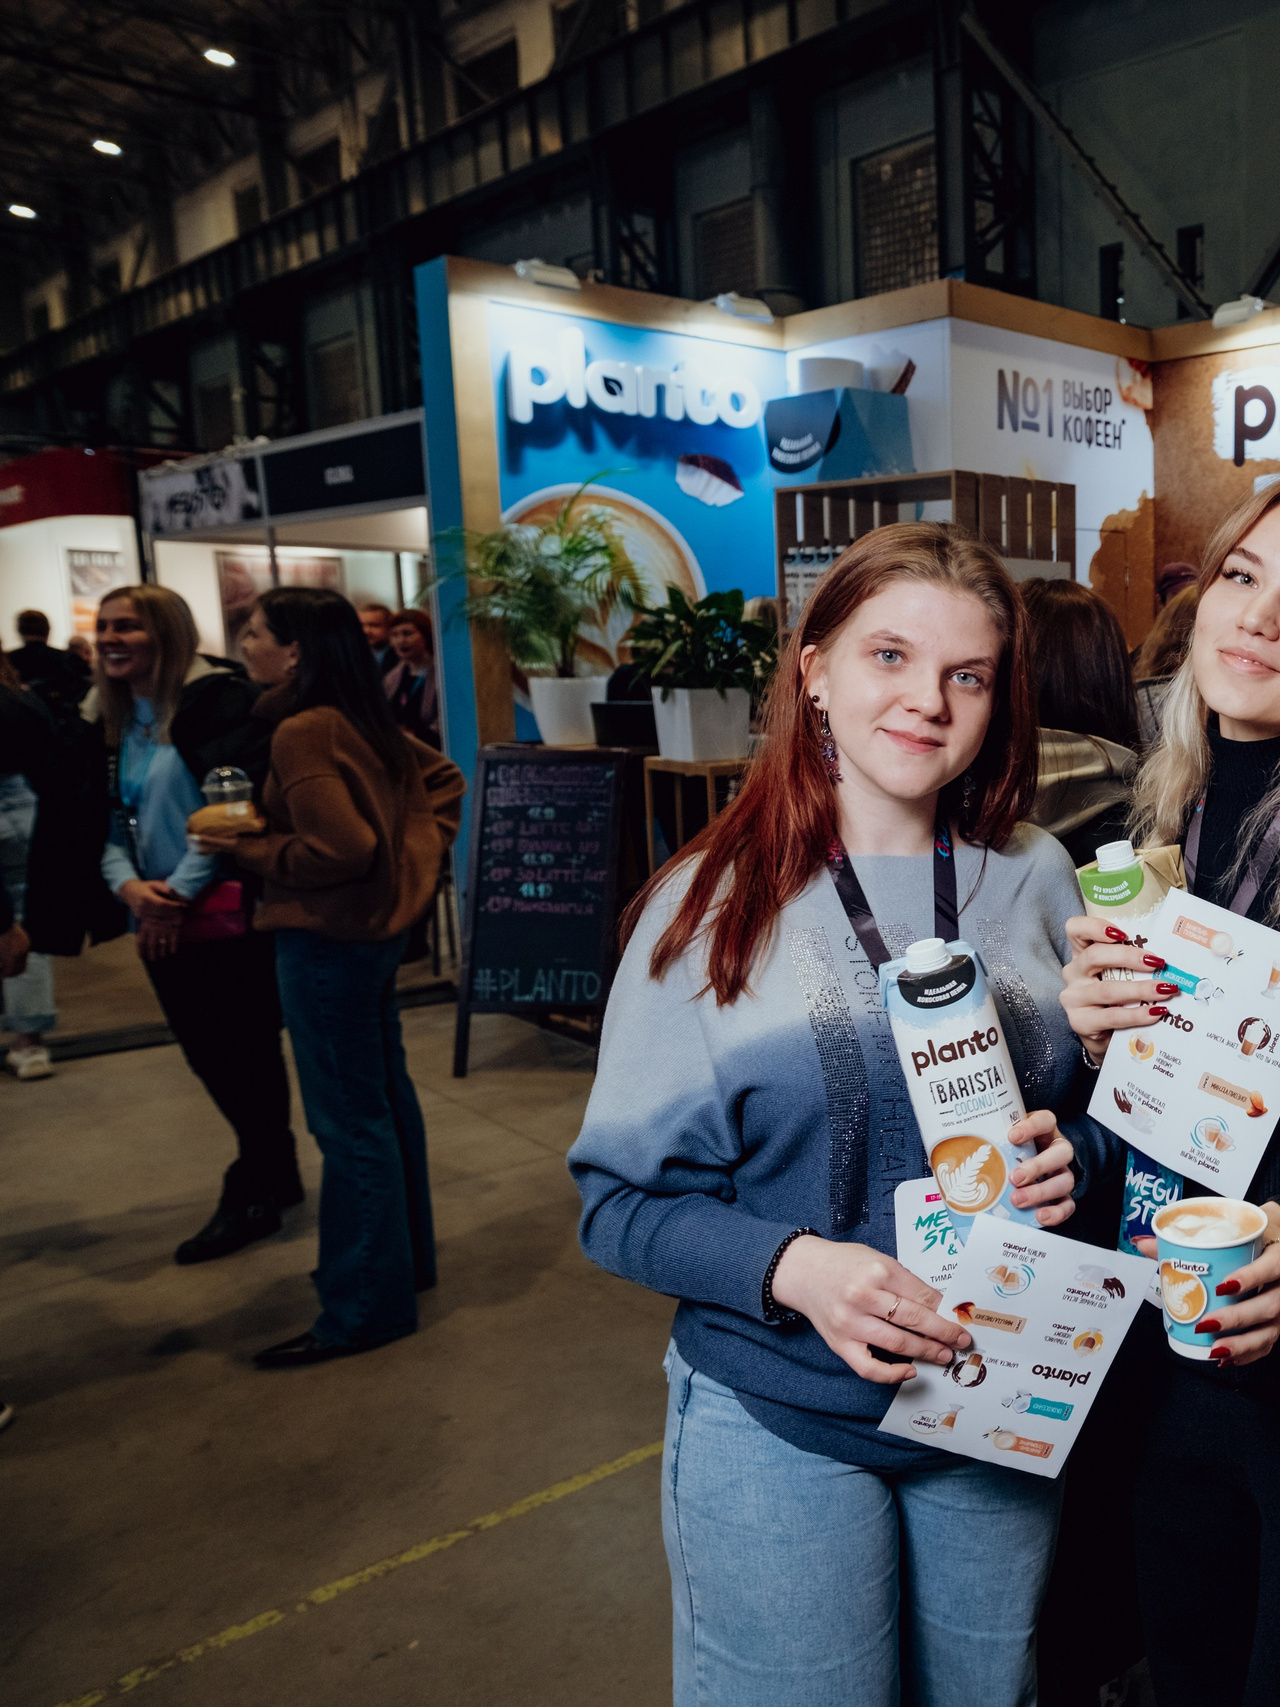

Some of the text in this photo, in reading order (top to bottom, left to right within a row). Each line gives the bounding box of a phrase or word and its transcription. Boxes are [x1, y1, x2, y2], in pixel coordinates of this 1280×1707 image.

[509, 326, 761, 428] planto
[1062, 379, 1113, 412] ВЫБОР
[474, 967, 601, 1003] #PLANTO
[924, 980, 958, 996] ИДЕАЛЬНАЯ
[911, 1026, 999, 1077] planto
[1268, 1033, 1280, 1054] planto
[1152, 1063, 1175, 1079] planto
[936, 1065, 1004, 1105] BARISTA
[954, 1091, 998, 1117] COCONUT
[1142, 1099, 1163, 1115] planto
[1197, 1159, 1220, 1174] planto
[1125, 1166, 1179, 1206] MEGU
[912, 1209, 948, 1232] ME
[921, 1226, 957, 1254] ST
[1002, 1241, 1027, 1253] planto
[947, 1243, 958, 1255] &
[942, 1262, 958, 1273] АЛИ
[1173, 1258, 1206, 1273] planto
[930, 1272, 955, 1284] ТИМА
[1066, 1287, 1091, 1298] planto
[1052, 1323, 1076, 1333] planto
[1031, 1364, 1092, 1388] planto
[912, 1419, 937, 1429] planto
